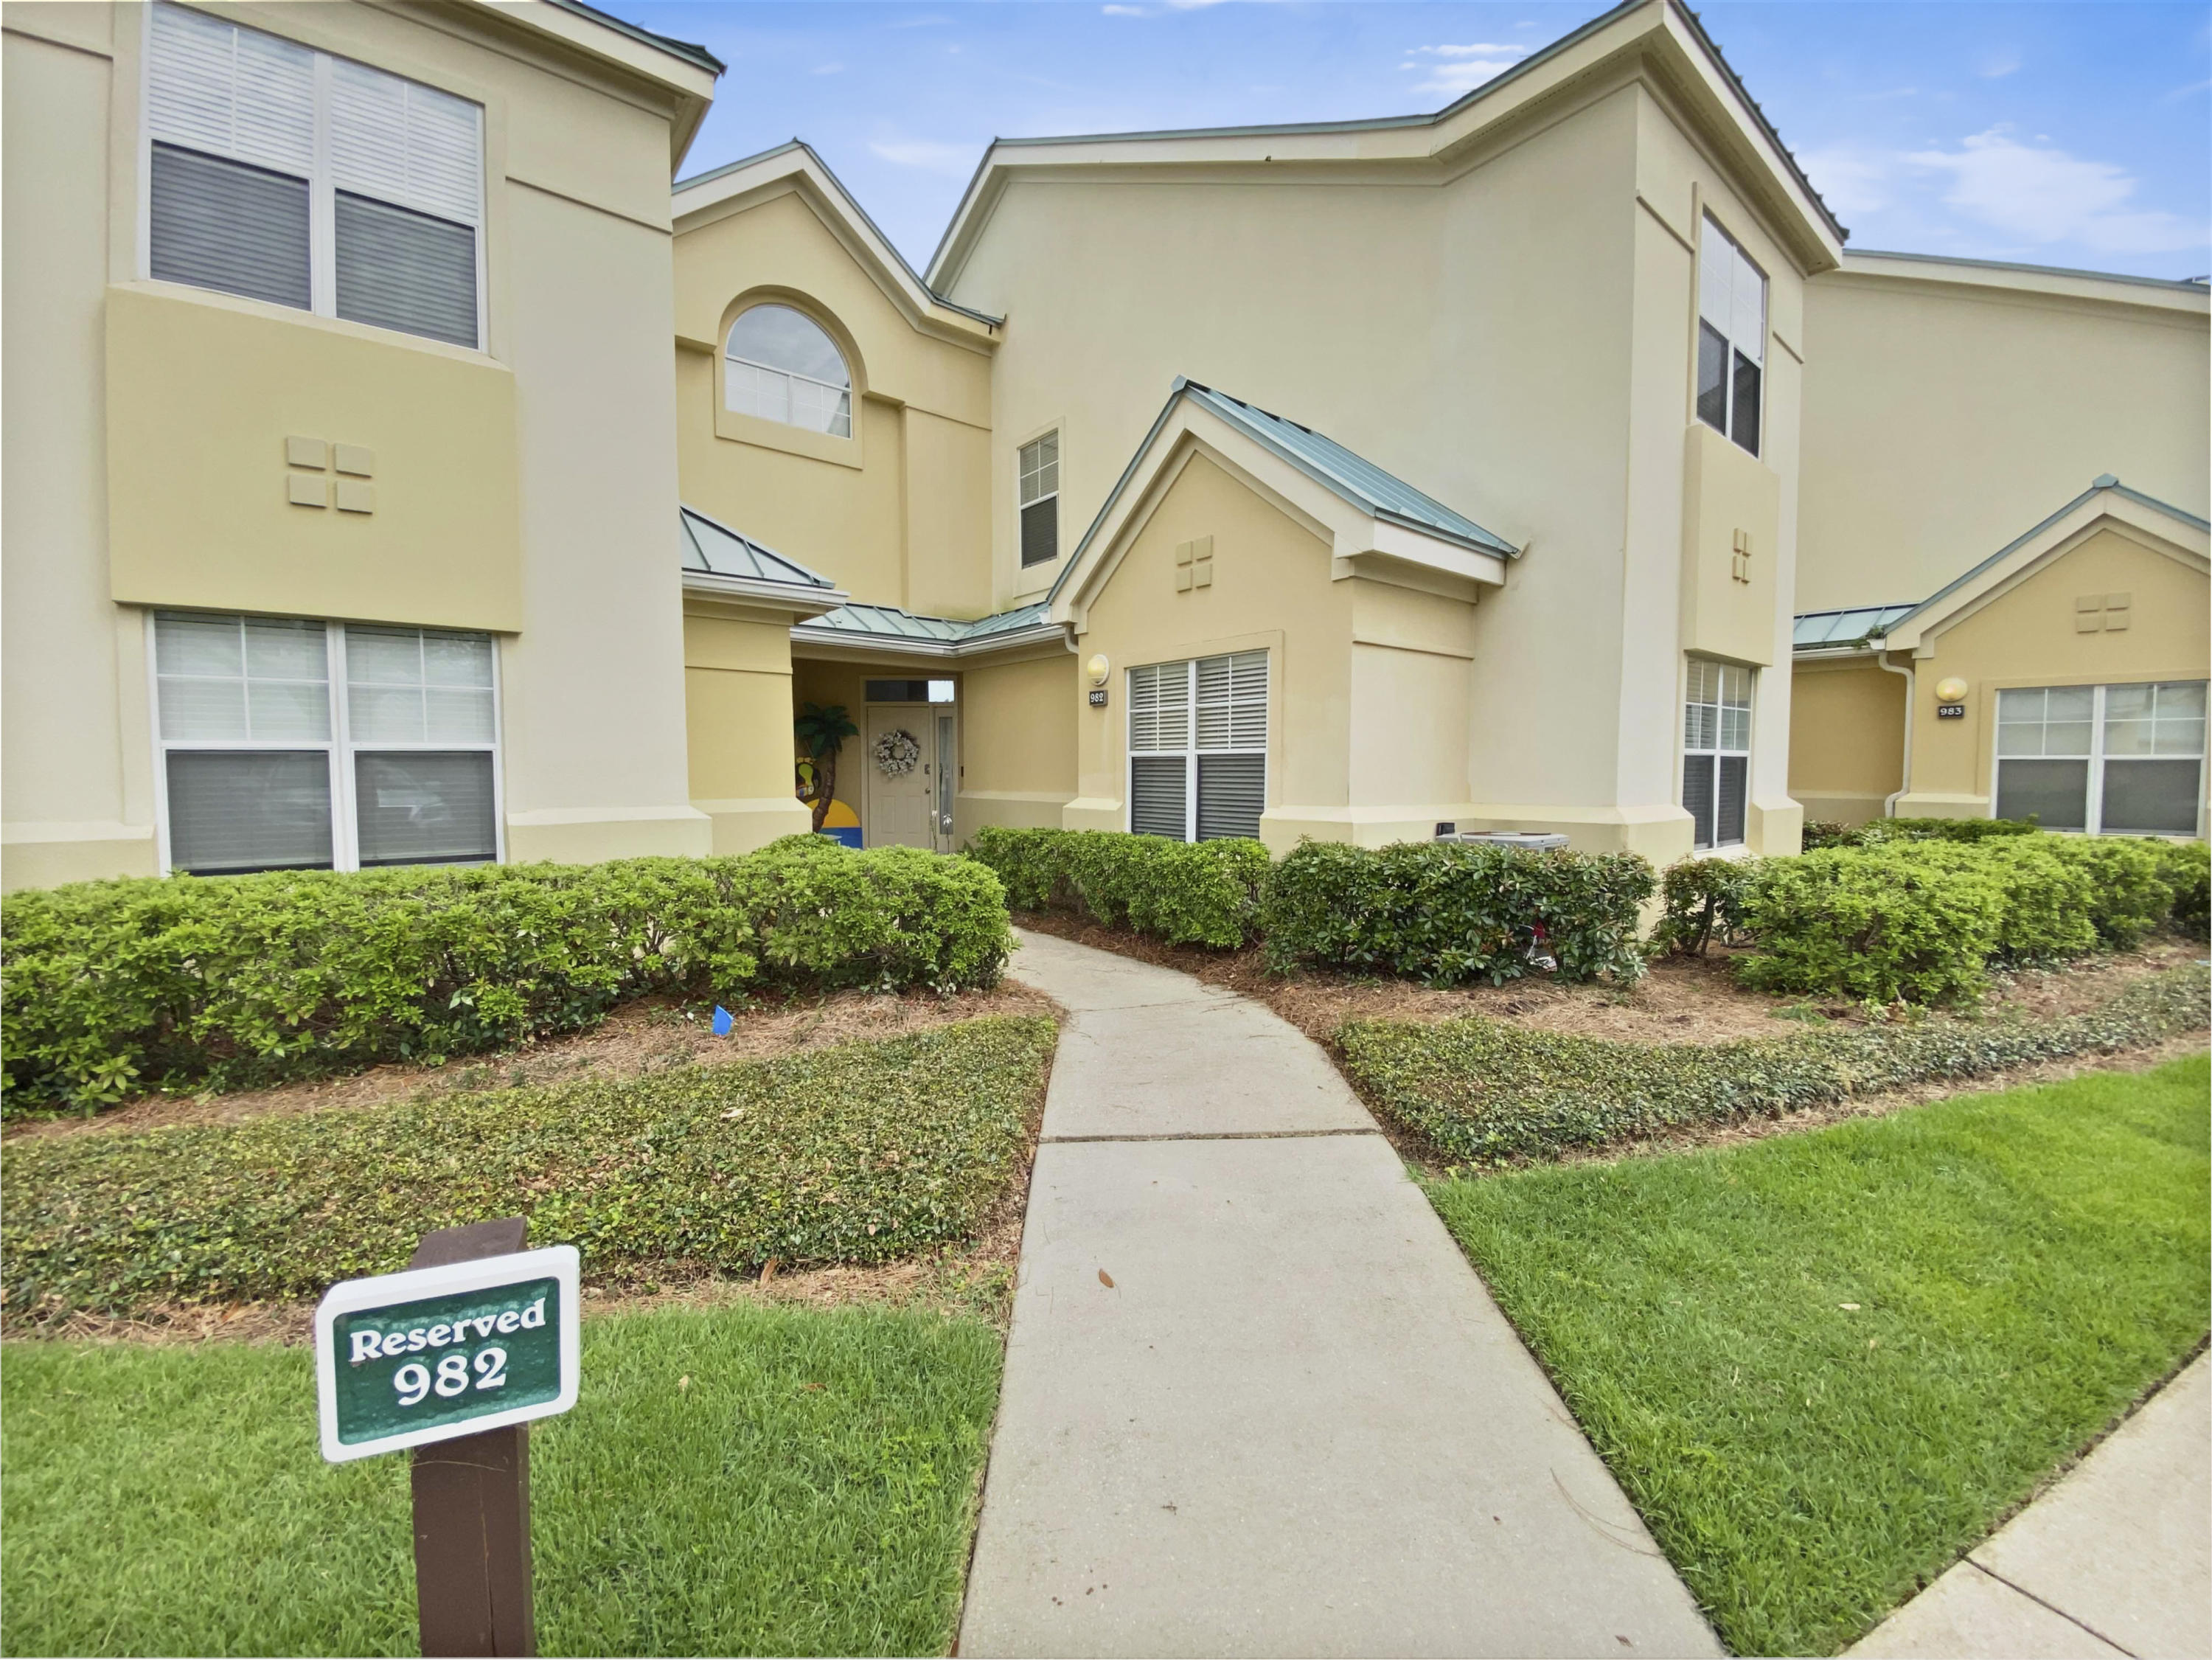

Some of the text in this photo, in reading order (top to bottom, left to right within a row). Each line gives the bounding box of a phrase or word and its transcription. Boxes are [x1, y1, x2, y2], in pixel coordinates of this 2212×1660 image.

[1091, 692, 1103, 703] 982
[1940, 707, 1962, 715] 983
[349, 1297, 546, 1362] Reserved
[394, 1347, 507, 1406] 982
